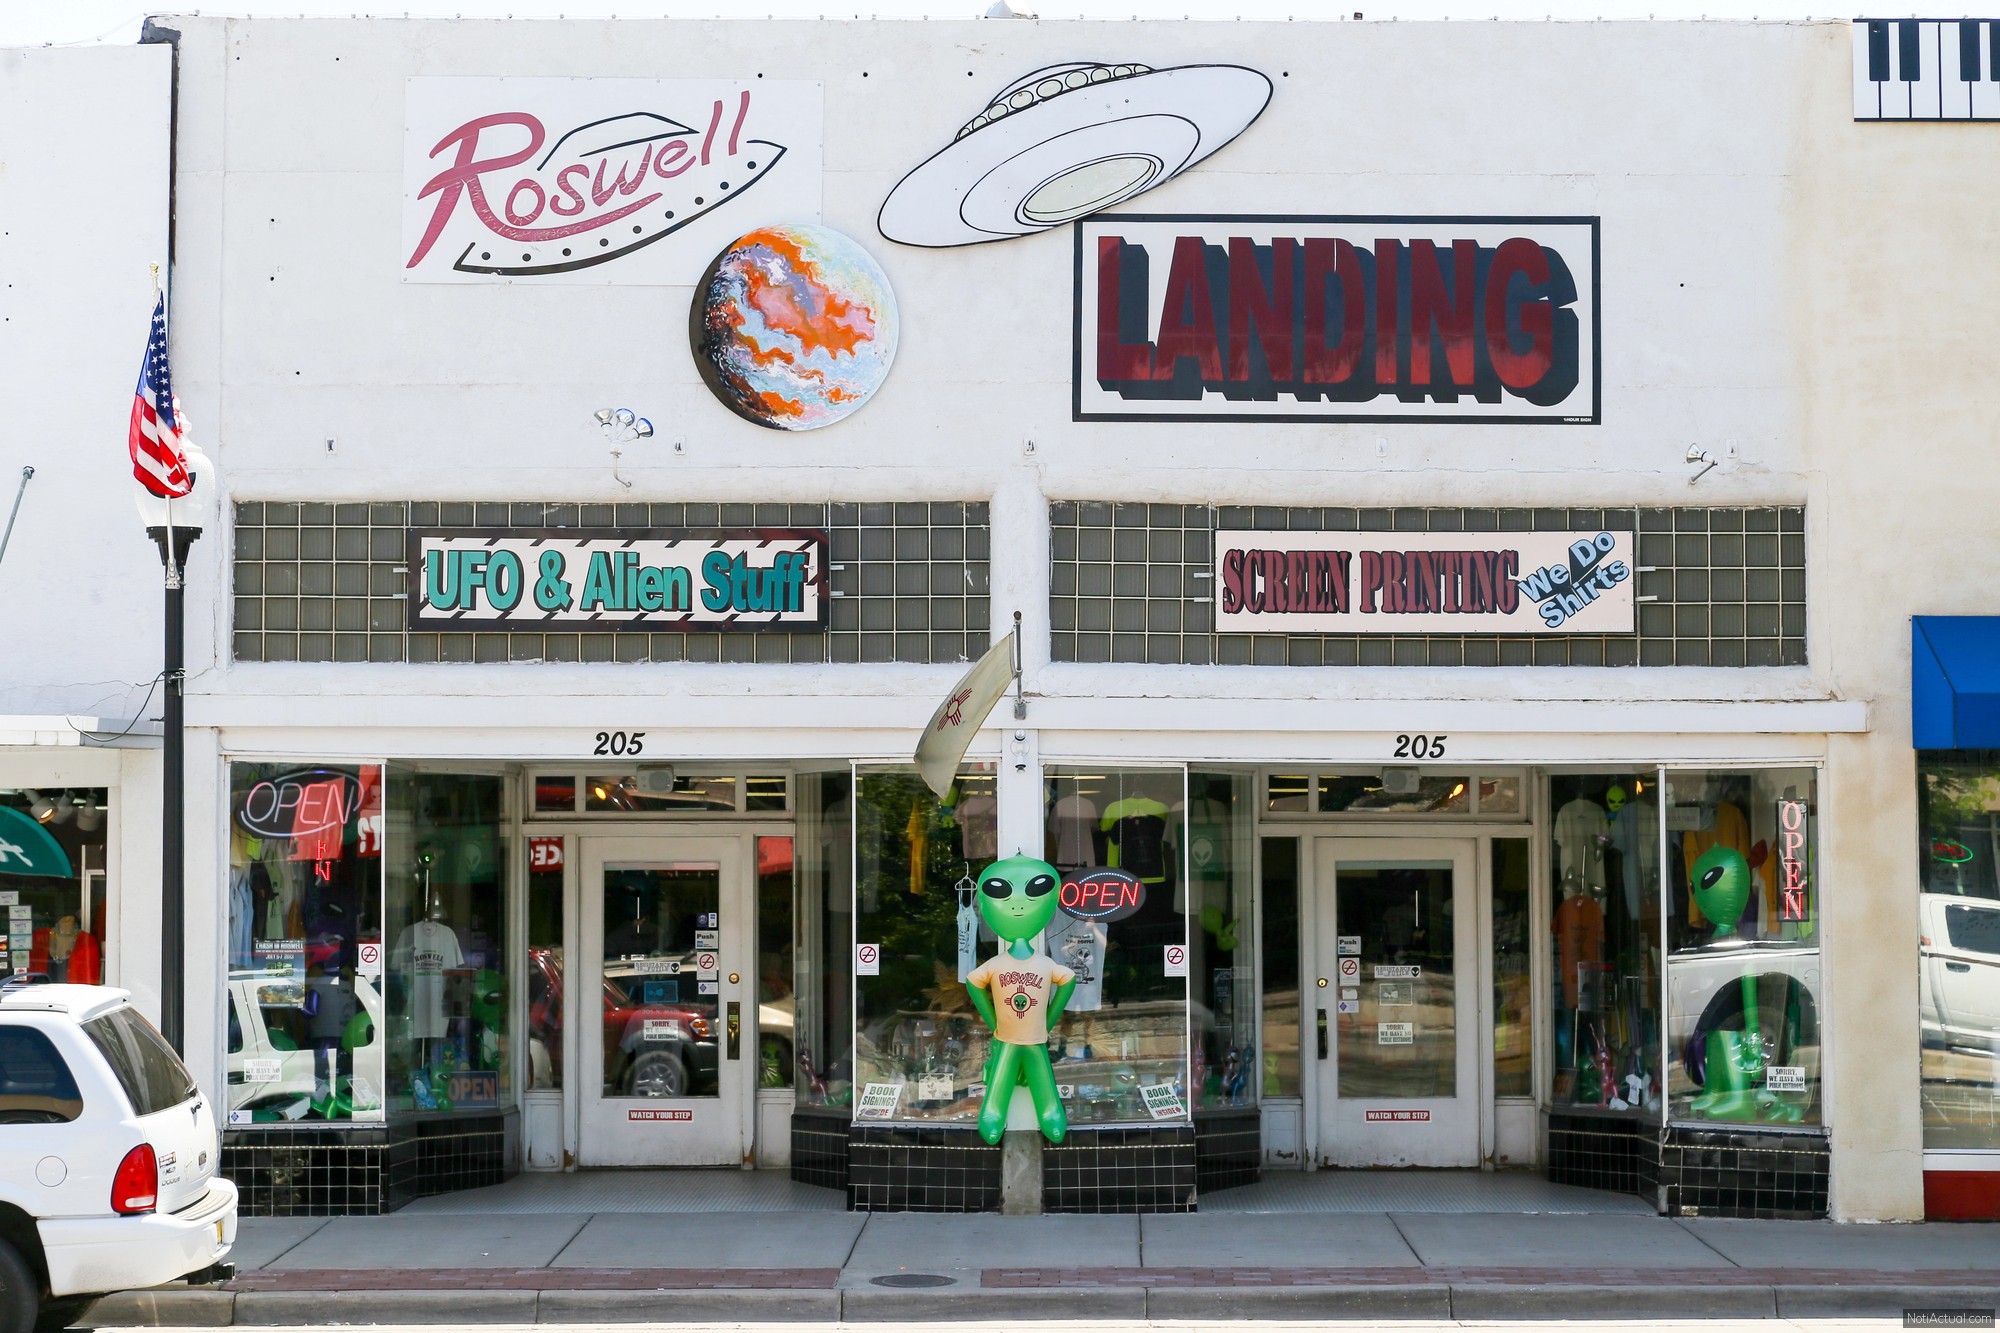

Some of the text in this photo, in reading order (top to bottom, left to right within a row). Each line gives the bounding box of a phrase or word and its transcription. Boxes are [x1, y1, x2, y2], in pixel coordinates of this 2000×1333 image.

[406, 90, 750, 268] Roswell
[1096, 236, 1570, 400] LANDING
[1518, 532, 1616, 603] We Do
[426, 549, 810, 613] UFO & Alien Stuff
[1222, 548, 1520, 615] SCREEN PRINTING
[1539, 561, 1629, 628] Shirts
[593, 731, 646, 756] 205
[1393, 734, 1447, 759] 205
[246, 781, 355, 825] OPEN
[1782, 802, 1805, 921] OPEN
[1060, 881, 1139, 907] OPEN
[414, 952, 444, 963] ROSWELL
[998, 971, 1043, 989] ROSWELL
[448, 1078, 496, 1102] OPEN
[862, 1095, 897, 1107] SIGNINGS
[869, 1086, 897, 1096] BOOK
[1146, 1086, 1171, 1099] BOOK
[1147, 1095, 1179, 1109] SIGNINGS
[630, 1111, 691, 1119] WATCH YOUR STEP
[1155, 1107, 1176, 1117] INSIDE
[1368, 1112, 1429, 1120] WATCH YOUR STEP
